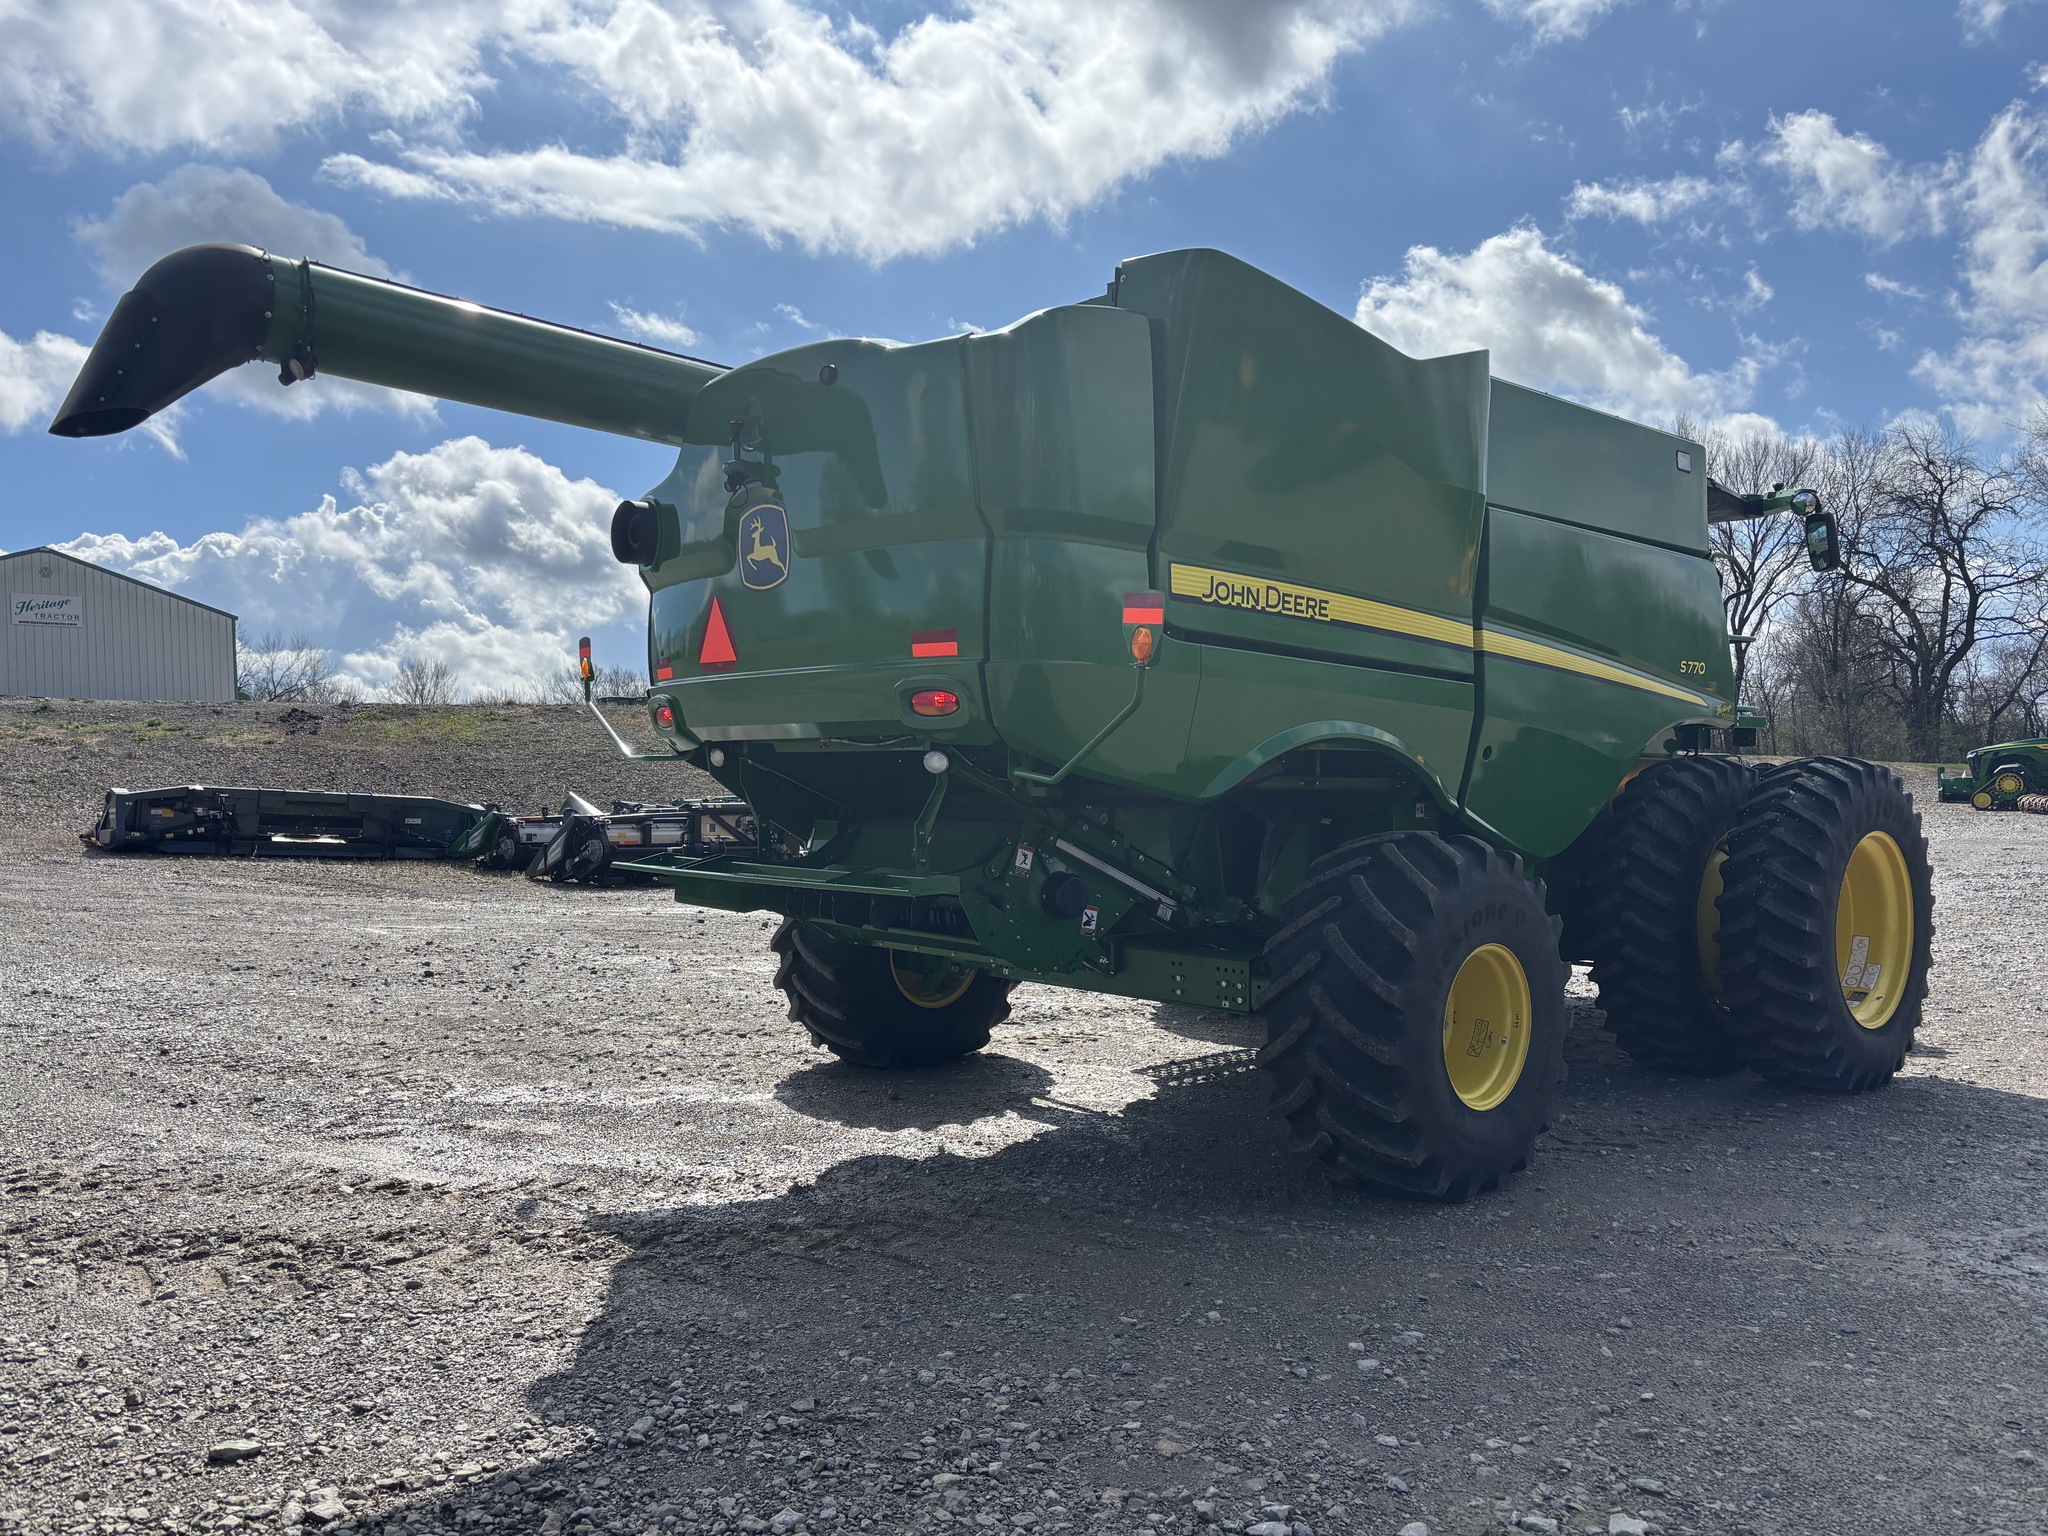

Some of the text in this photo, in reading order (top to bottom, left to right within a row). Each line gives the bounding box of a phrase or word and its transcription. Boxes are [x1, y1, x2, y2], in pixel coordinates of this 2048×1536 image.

[1202, 575, 1331, 621] JOHN DEERE
[14, 599, 71, 615] Heritage
[34, 613, 80, 621] TRACTOR
[1680, 660, 1706, 675] S770
